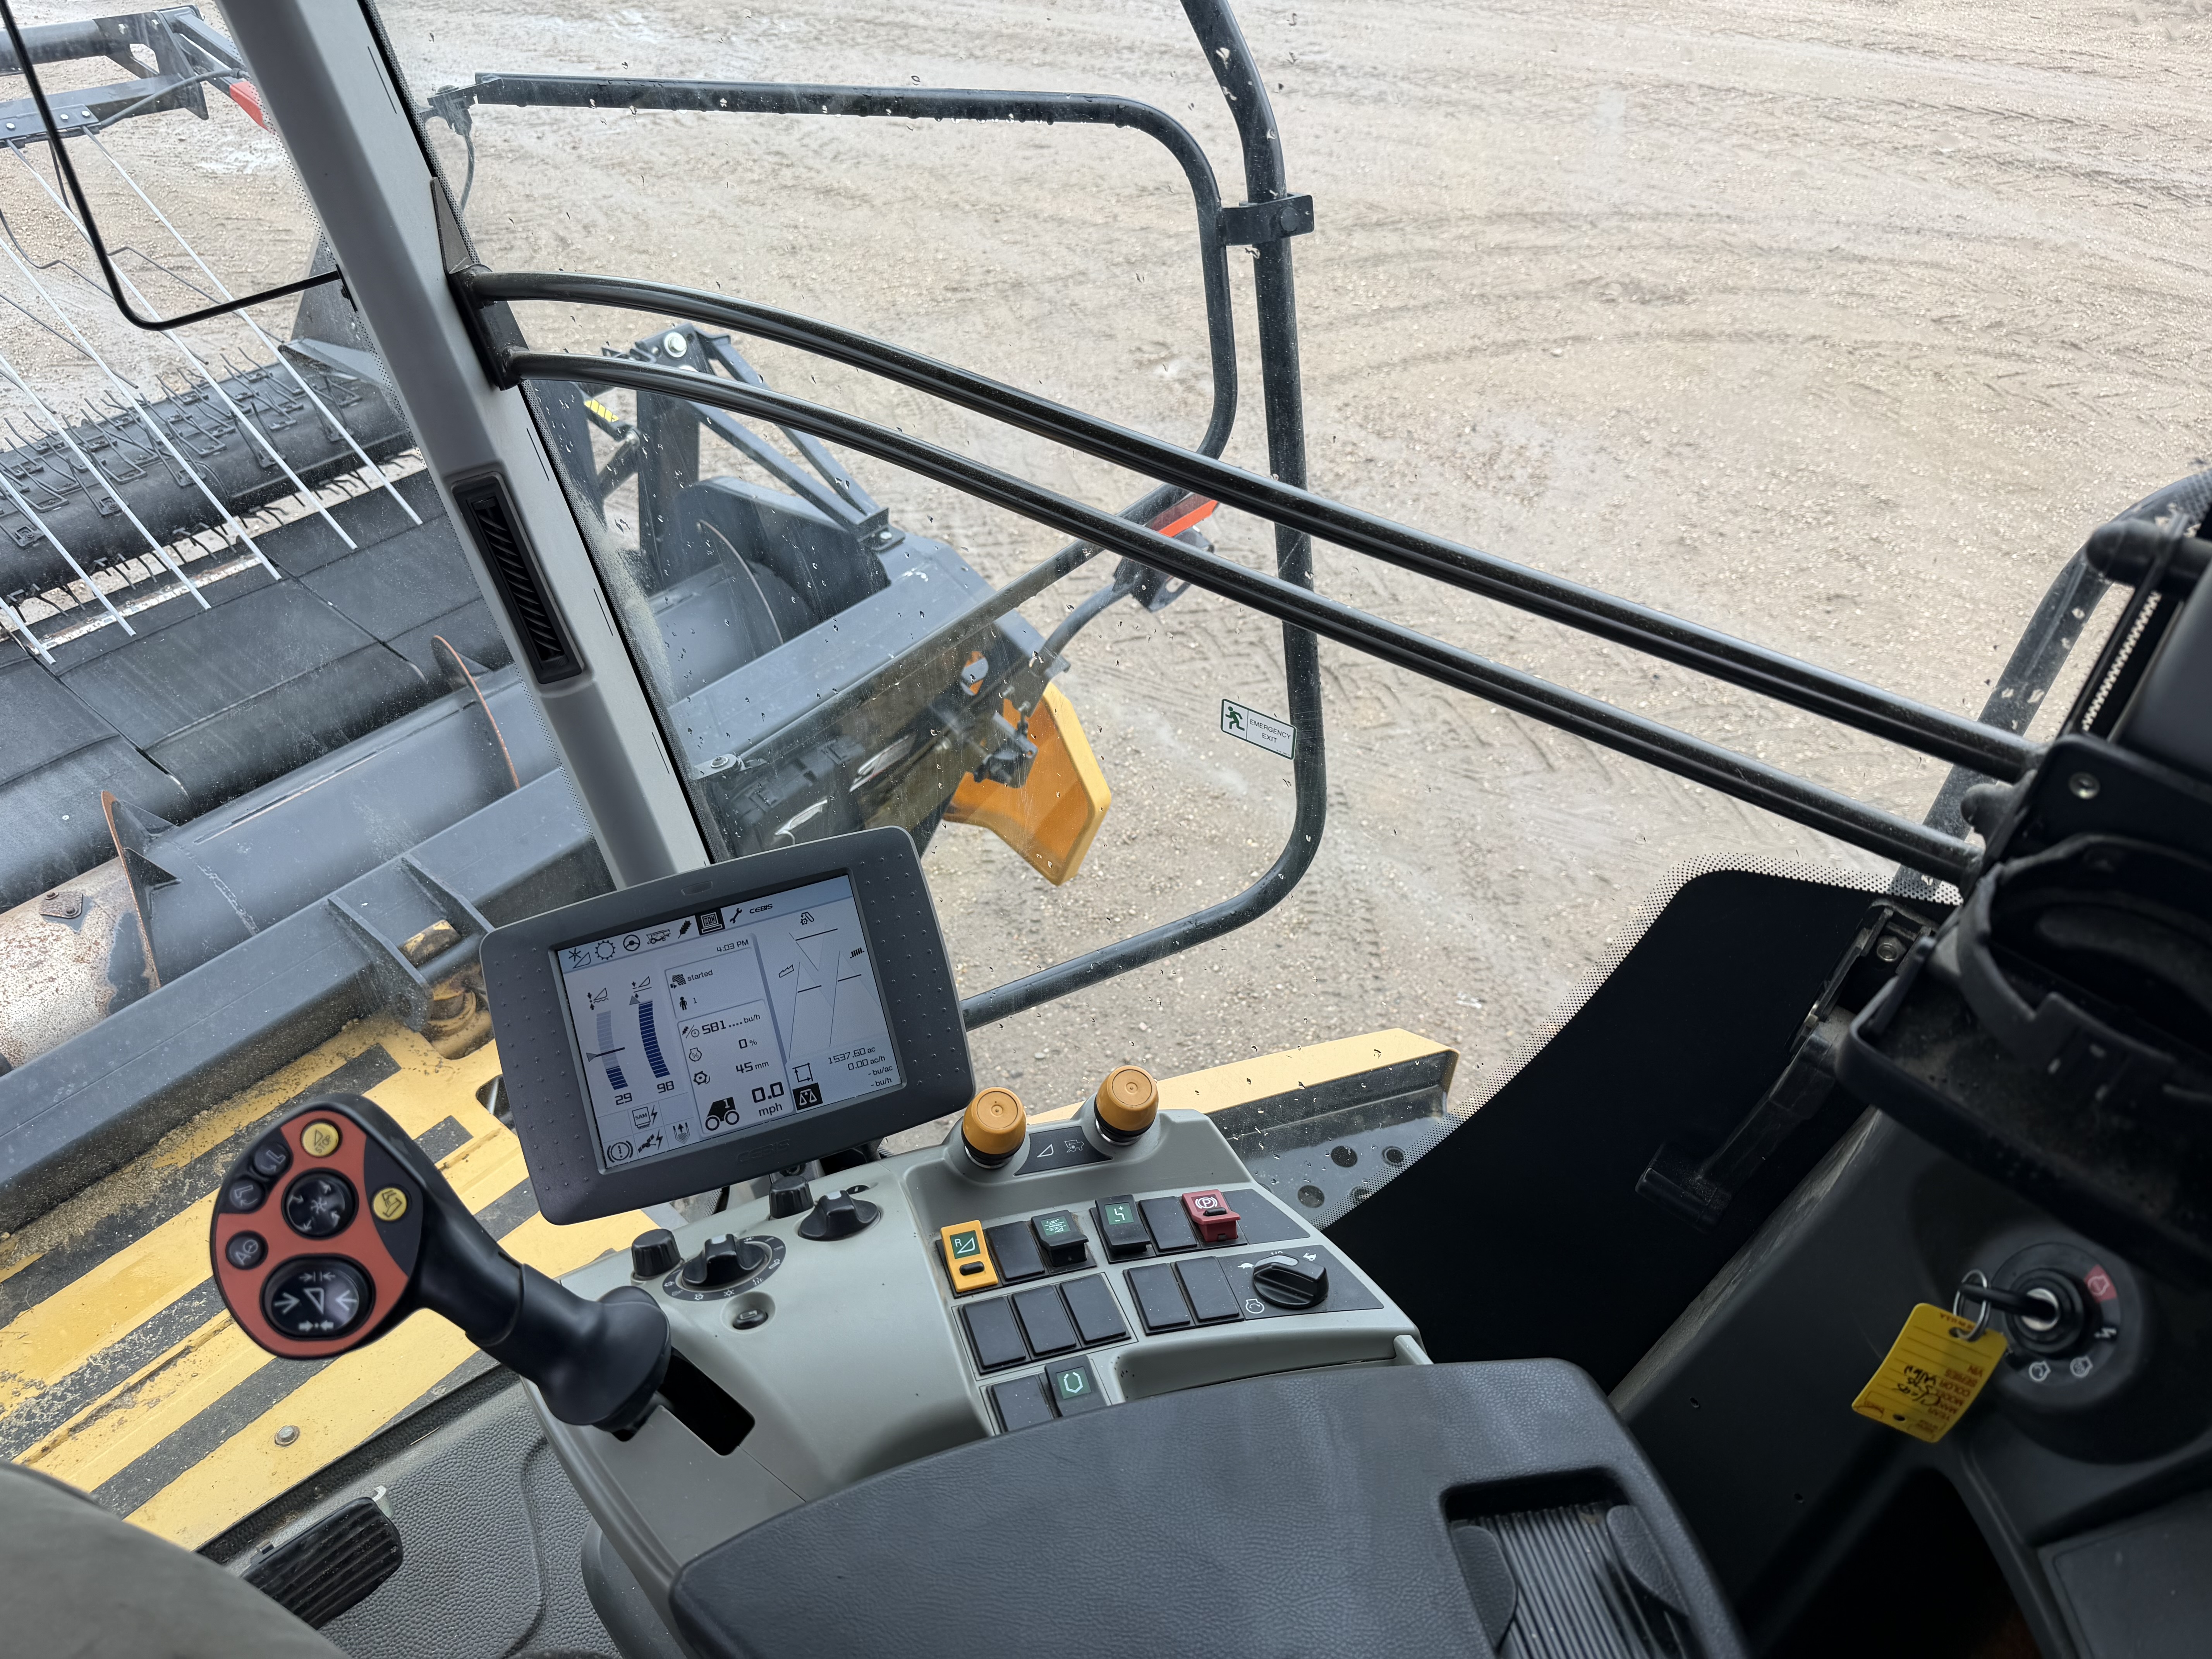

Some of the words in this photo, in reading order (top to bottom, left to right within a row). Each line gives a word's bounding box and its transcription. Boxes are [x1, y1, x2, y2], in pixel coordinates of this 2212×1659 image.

[1250, 719, 1291, 739] EMERGENCY
[1262, 733, 1278, 743] EXIT
[749, 903, 773, 914] CEBIS
[717, 943, 735, 952] 4:03
[687, 969, 713, 981] started
[744, 1014, 761, 1023] bu/h
[738, 1039, 748, 1049] 0
[828, 1048, 866, 1064] 1537.60
[736, 1061, 753, 1073] 45
[755, 1061, 769, 1070] mm
[848, 1059, 869, 1070] 0.00
[870, 1056, 886, 1065] ac/h
[872, 1066, 893, 1075] bu/ac
[657, 1080, 675, 1094] 98
[875, 1077, 892, 1087] bu/h
[615, 1092, 632, 1105] 29
[752, 1082, 784, 1103] 0.0
[723, 1099, 730, 1109] 1
[759, 1103, 783, 1116] mph
[315, 1135, 331, 1153] STOP
[1202, 1199, 1211, 1207] P
[954, 1238, 962, 1247] R
[1967, 1365, 1983, 1377] VIN
[1939, 1379, 1971, 1397] COLOR
